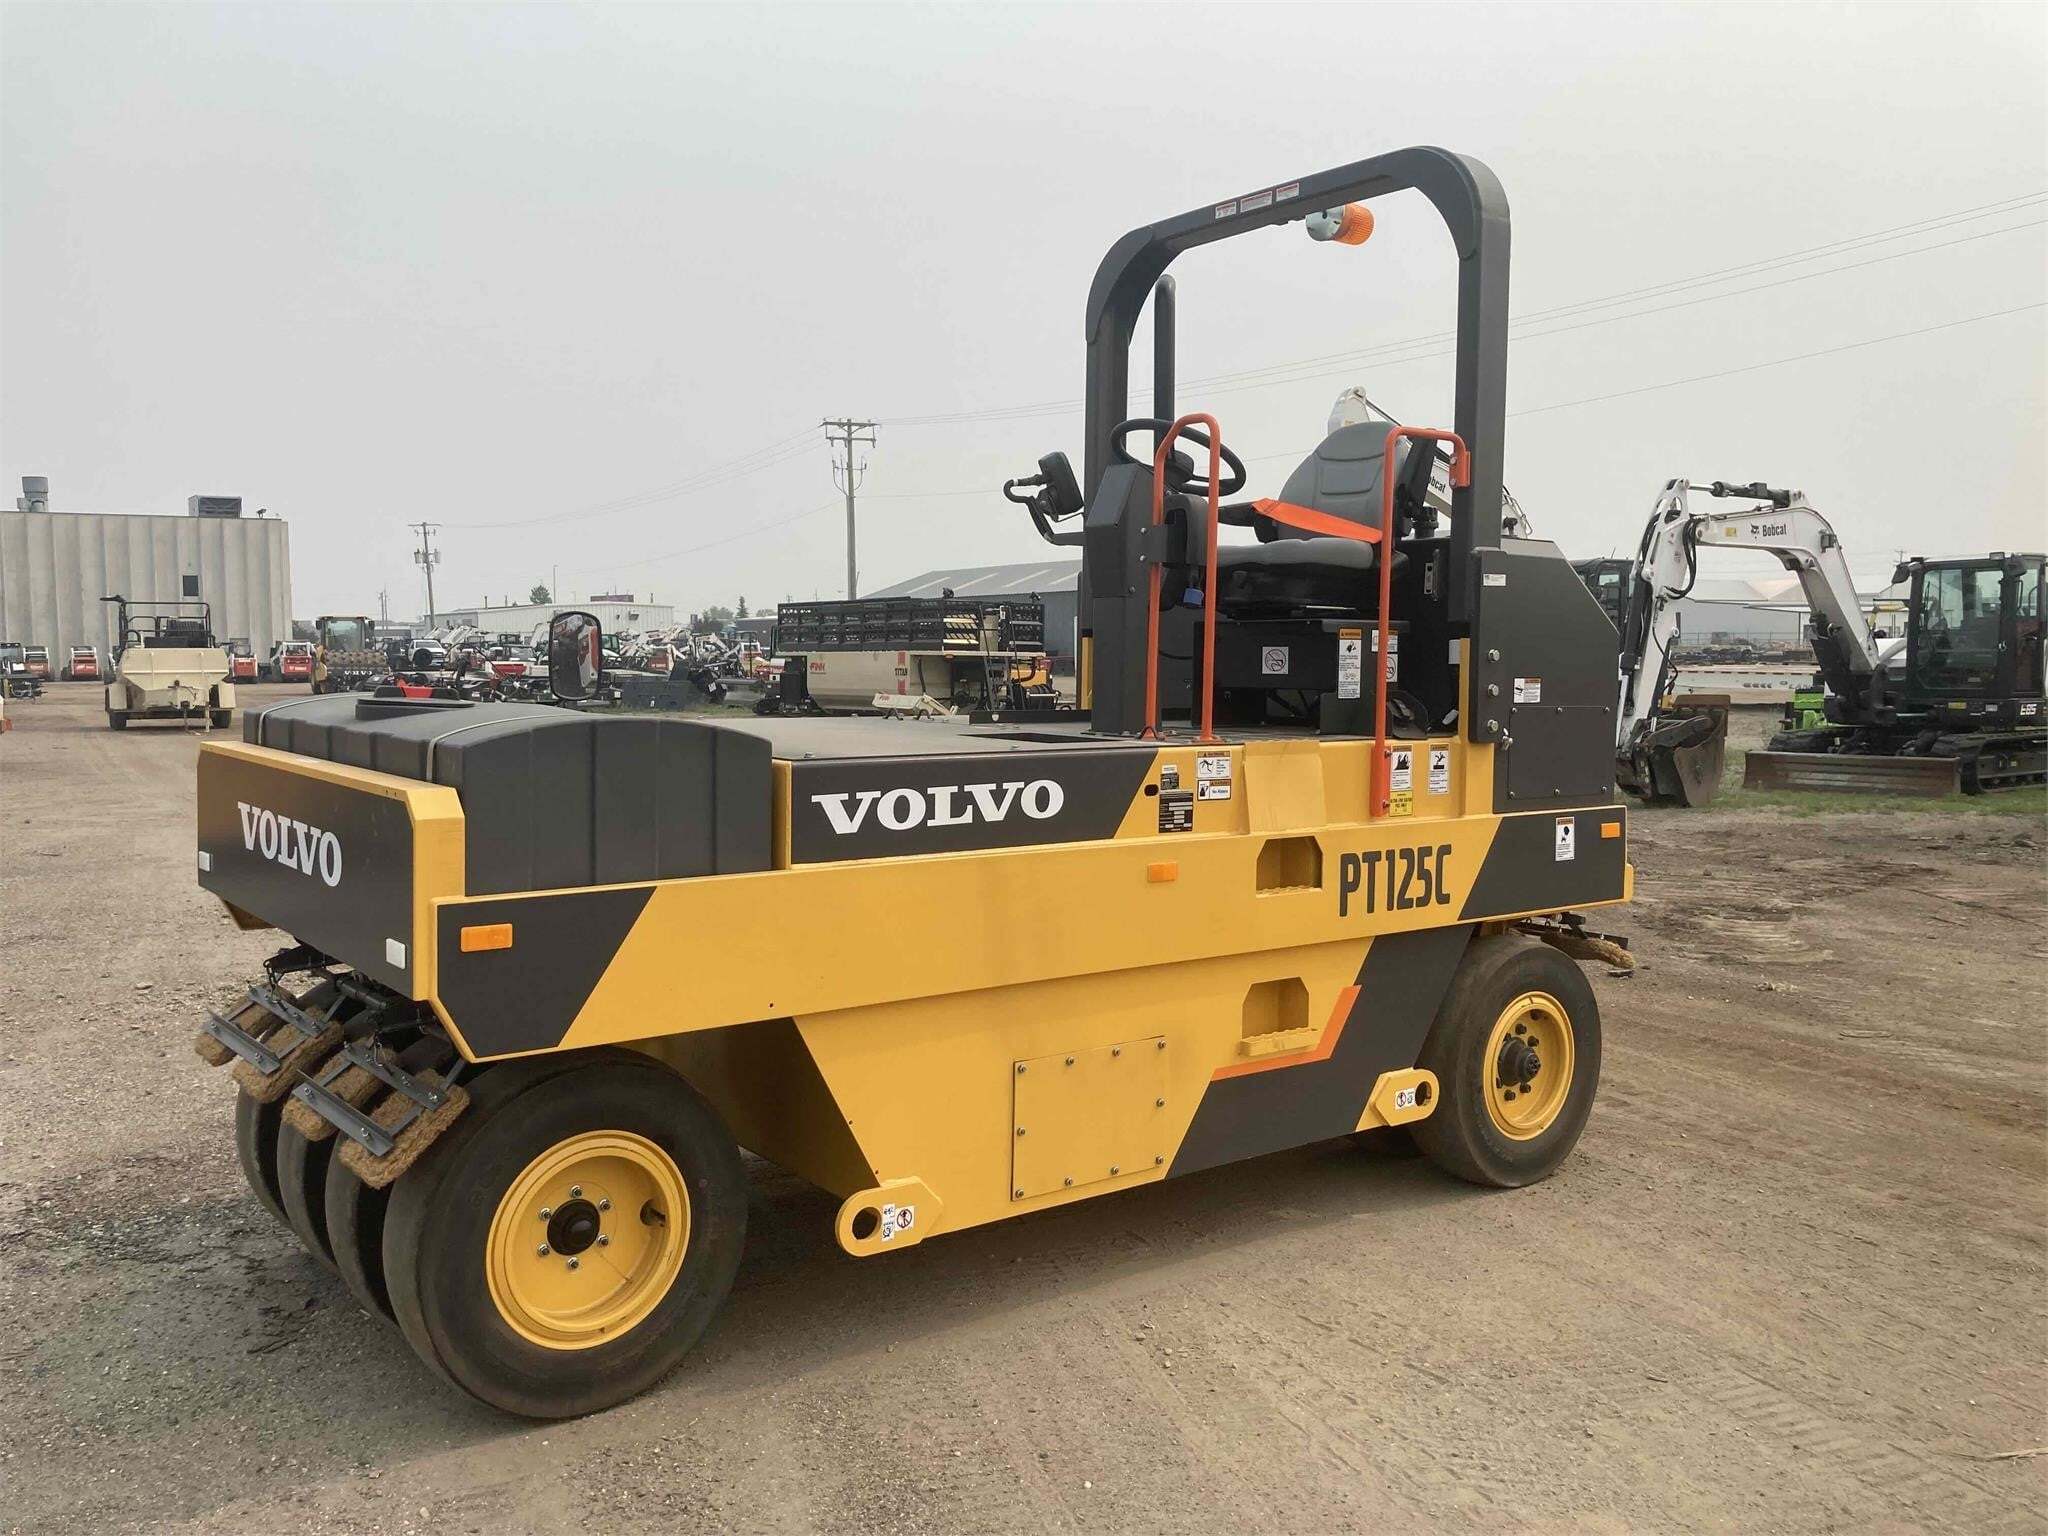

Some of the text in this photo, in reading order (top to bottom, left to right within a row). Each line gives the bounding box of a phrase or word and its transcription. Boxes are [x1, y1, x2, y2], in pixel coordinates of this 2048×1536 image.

[1429, 476, 1445, 493] bcat
[1762, 523, 1787, 536] Bobcat
[2020, 703, 2037, 716] E85
[811, 779, 1064, 835] VOLVO
[237, 801, 343, 887] VOLVO
[1339, 844, 1452, 917] PT125C
